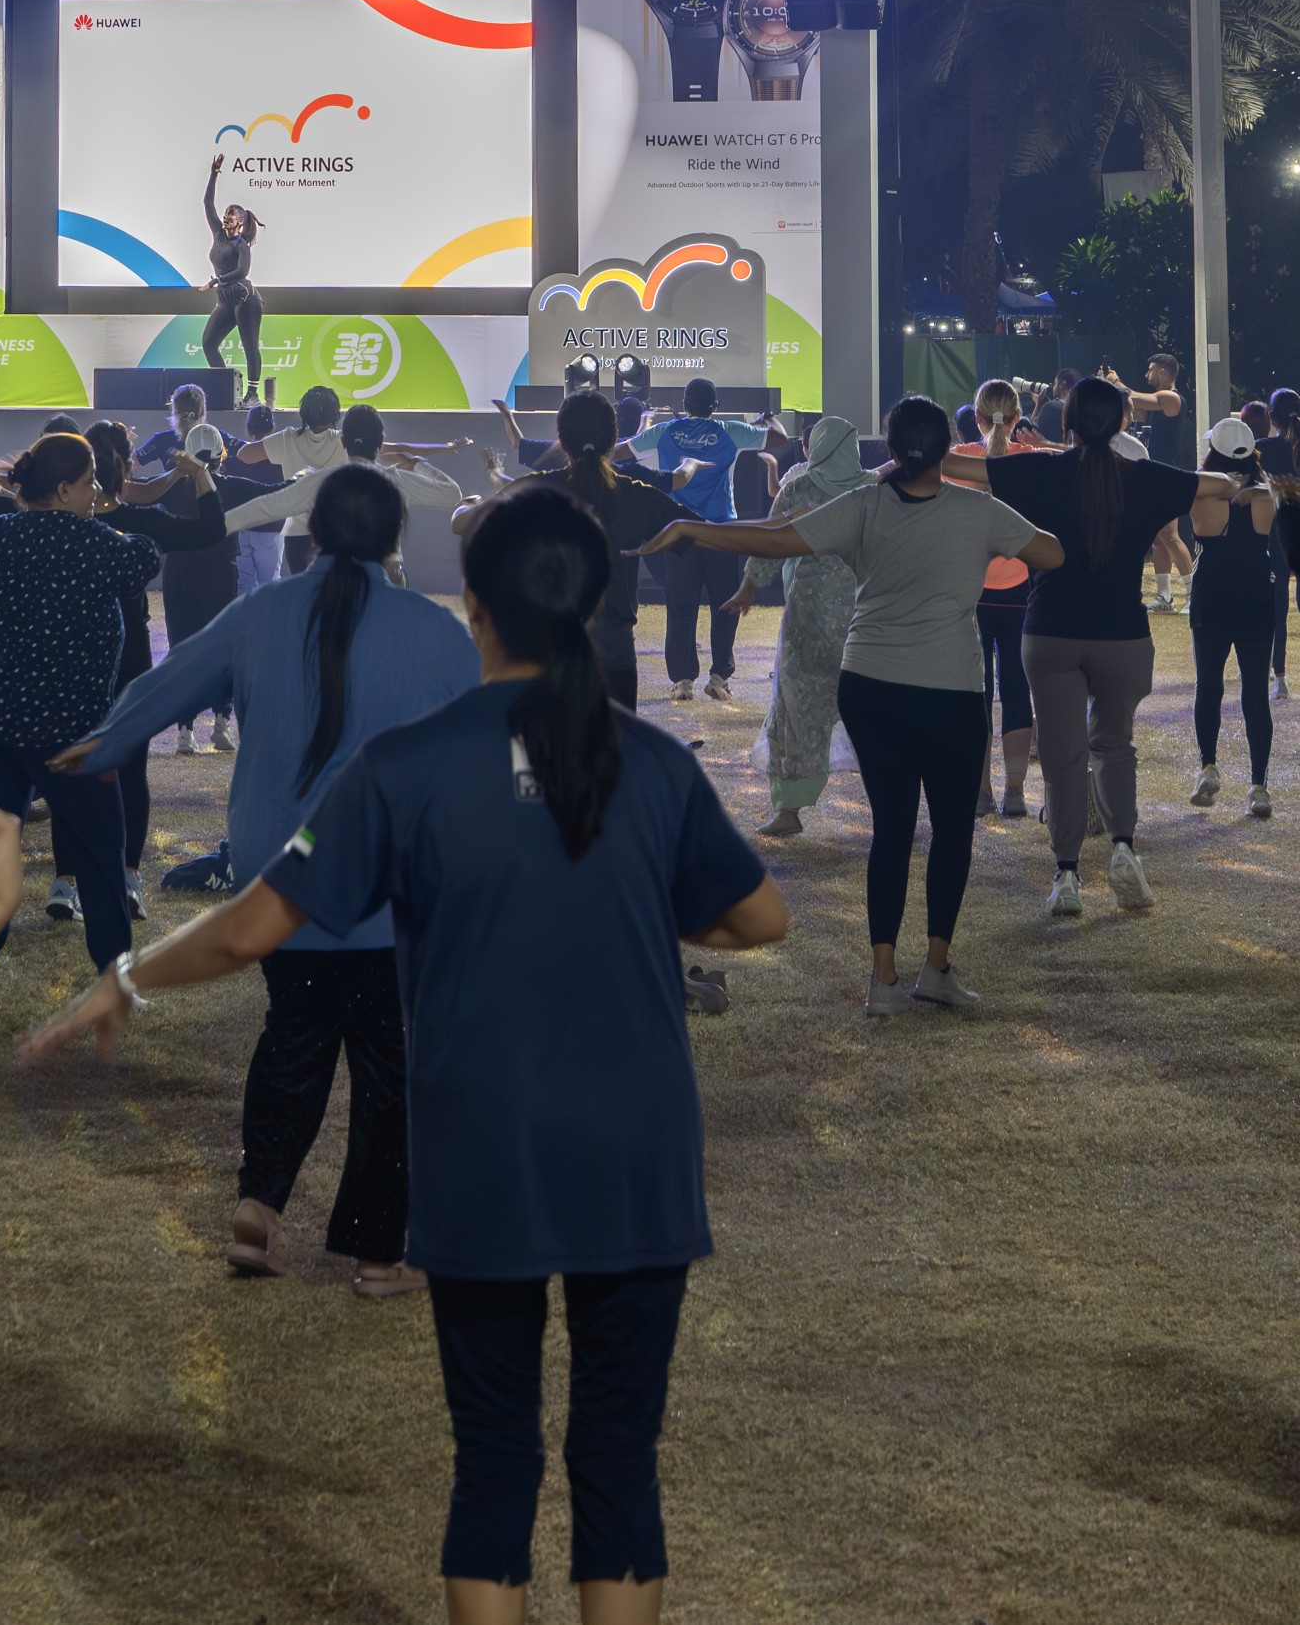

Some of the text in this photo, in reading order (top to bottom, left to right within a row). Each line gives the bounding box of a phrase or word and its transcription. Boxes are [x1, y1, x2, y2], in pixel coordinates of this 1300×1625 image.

[752, 6, 787, 16] 10:0
[96, 18, 141, 28] HUAWEI
[645, 134, 821, 146] HUAWEI WATCH GT 6 Pro
[232, 157, 354, 172] ACTIVE RINGS
[688, 158, 780, 170] Ride the Wind
[249, 179, 335, 189] Enjoy Your Moment
[562, 327, 729, 349] ACTIVE RINGS
[652, 356, 705, 368] Moment
